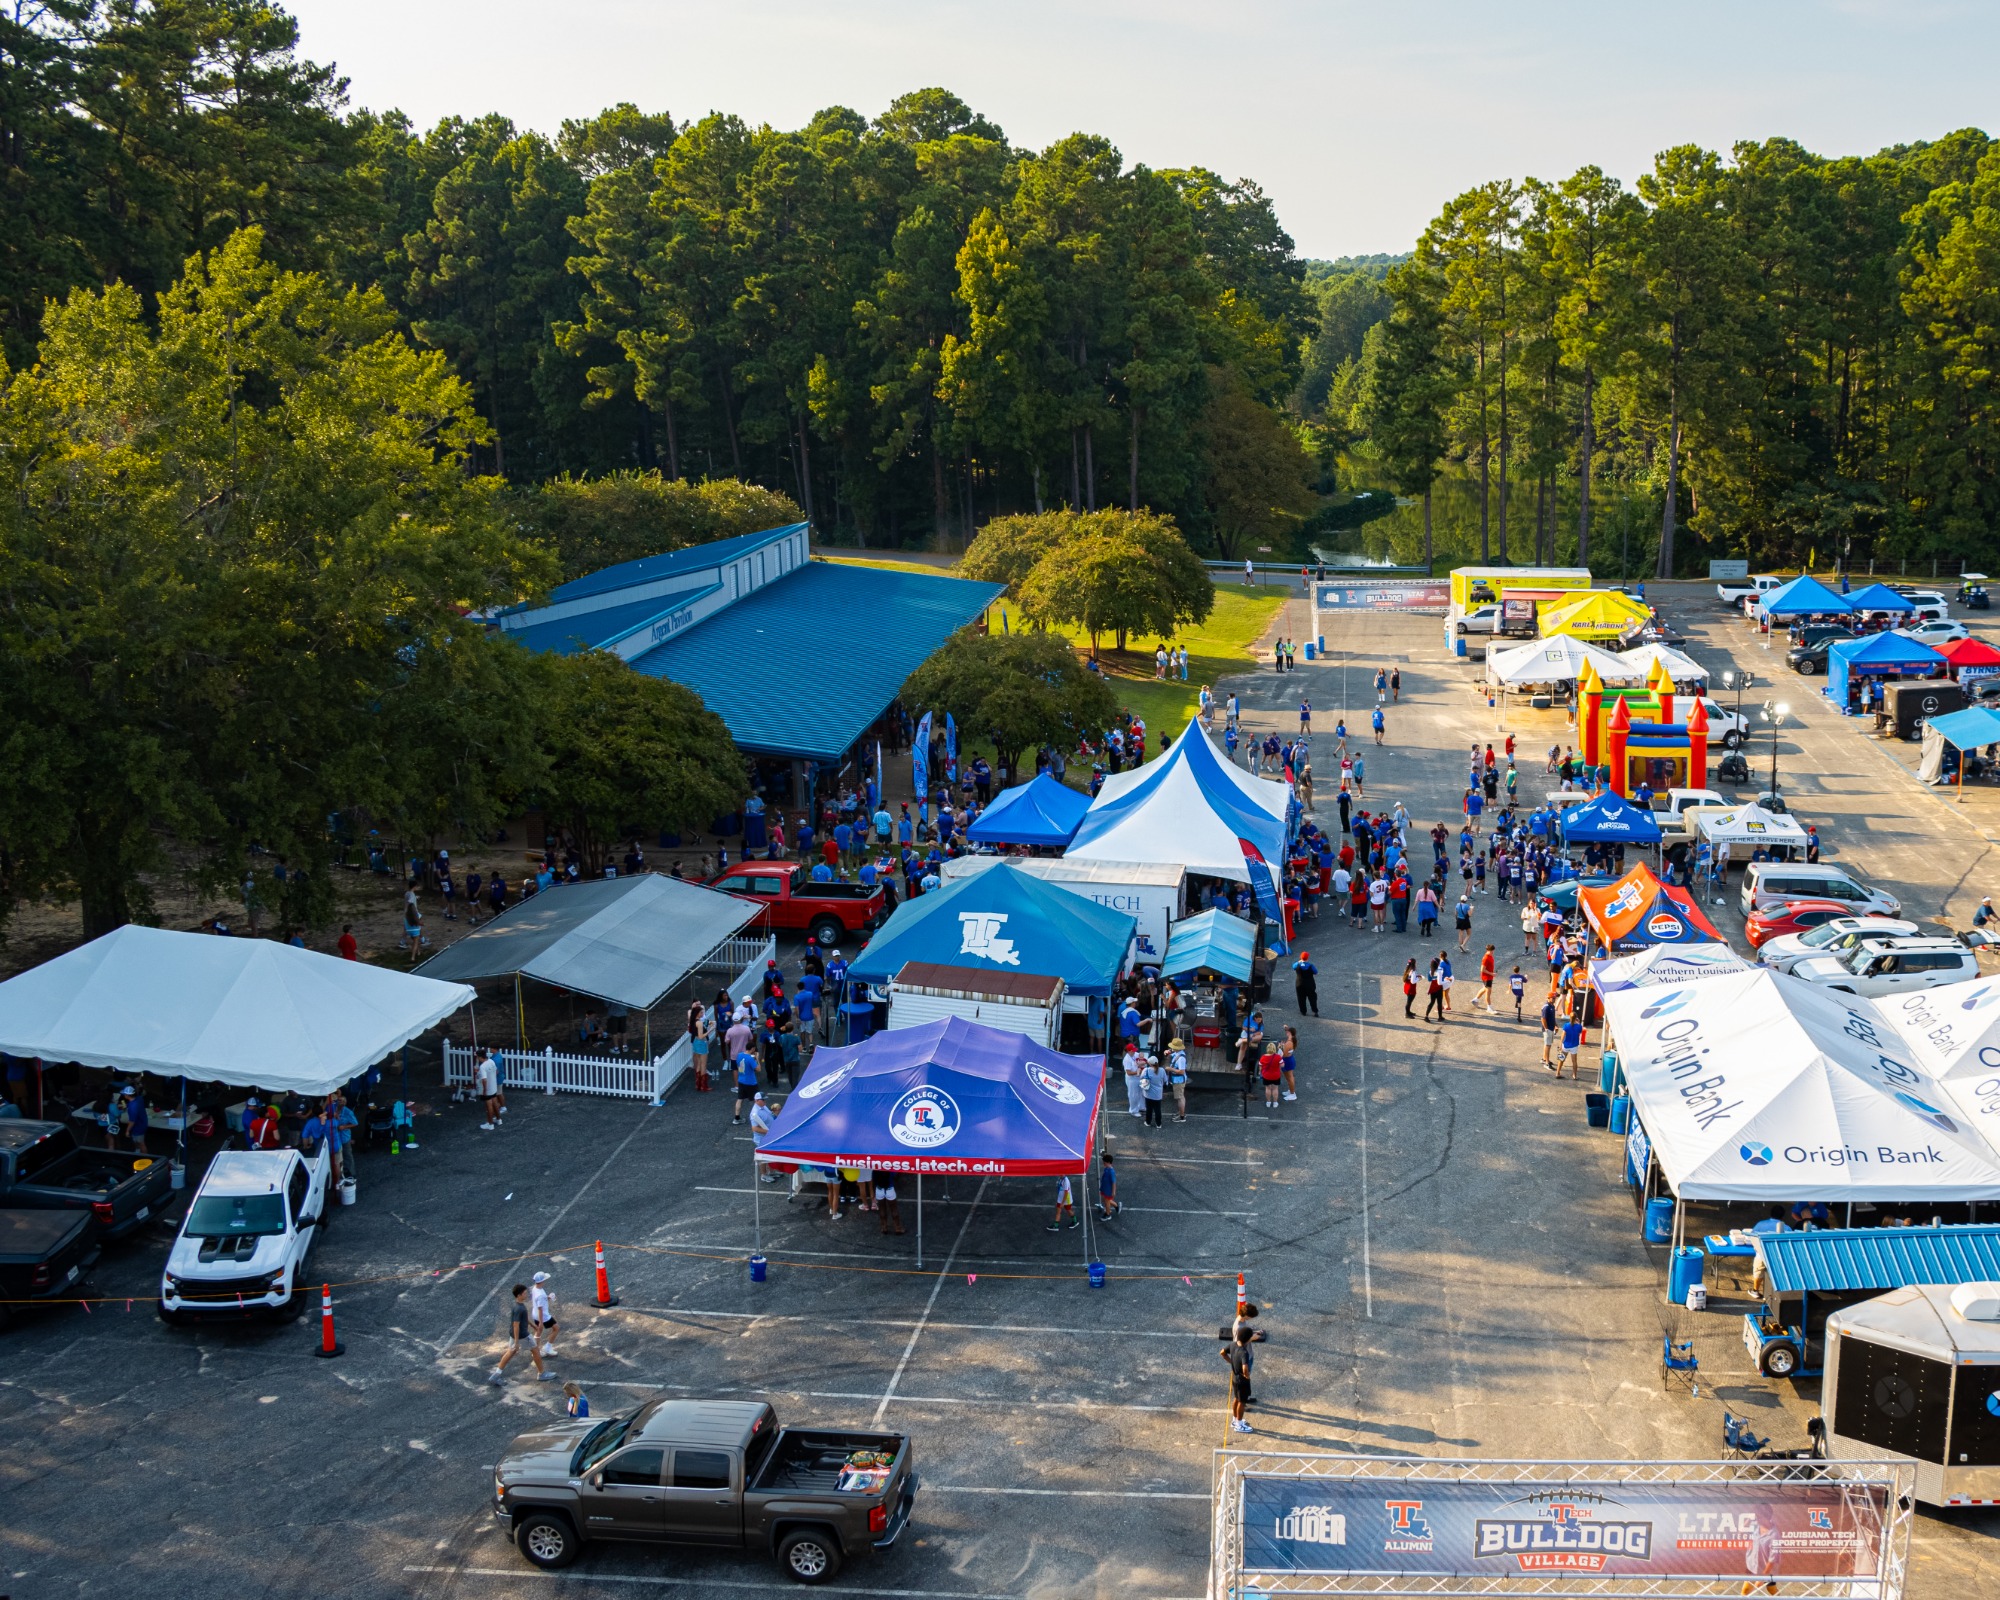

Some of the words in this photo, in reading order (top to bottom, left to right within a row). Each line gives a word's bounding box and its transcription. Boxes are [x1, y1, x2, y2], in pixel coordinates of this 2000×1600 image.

[1367, 594, 1402, 602] BULLDOG
[1597, 822, 1612, 830] AIR
[1376, 884, 1386, 894] 31
[1091, 895, 1141, 910] TECH
[832, 969, 843, 980] 71
[1647, 967, 1695, 975] Northern
[1903, 995, 1940, 1030] Origin
[1927, 1024, 1967, 1057] Bank
[1651, 1019, 1710, 1081] Origin
[903, 1091, 938, 1108] COLLEGE
[940, 1100, 950, 1110] OF
[1680, 1074, 1744, 1131] Bank
[900, 1130, 946, 1143] BUSINESS
[1784, 1145, 1868, 1166] Origin
[1879, 1145, 1944, 1164] Bank
[835, 1155, 1005, 1174] business.latech.edu
[1289, 1505, 1333, 1517] BARK
[1538, 1509, 1553, 1517] LA
[1677, 1513, 1756, 1533] LTAC
[1275, 1514, 1347, 1546] LOUDER
[1782, 1531, 1830, 1539] LOUISIANA
[1832, 1531, 1856, 1539] TECH
[1480, 1524, 1647, 1554] BULLDOG
[1384, 1541, 1433, 1551] ALUMNI
[1523, 1555, 1601, 1568] VILLAGE
